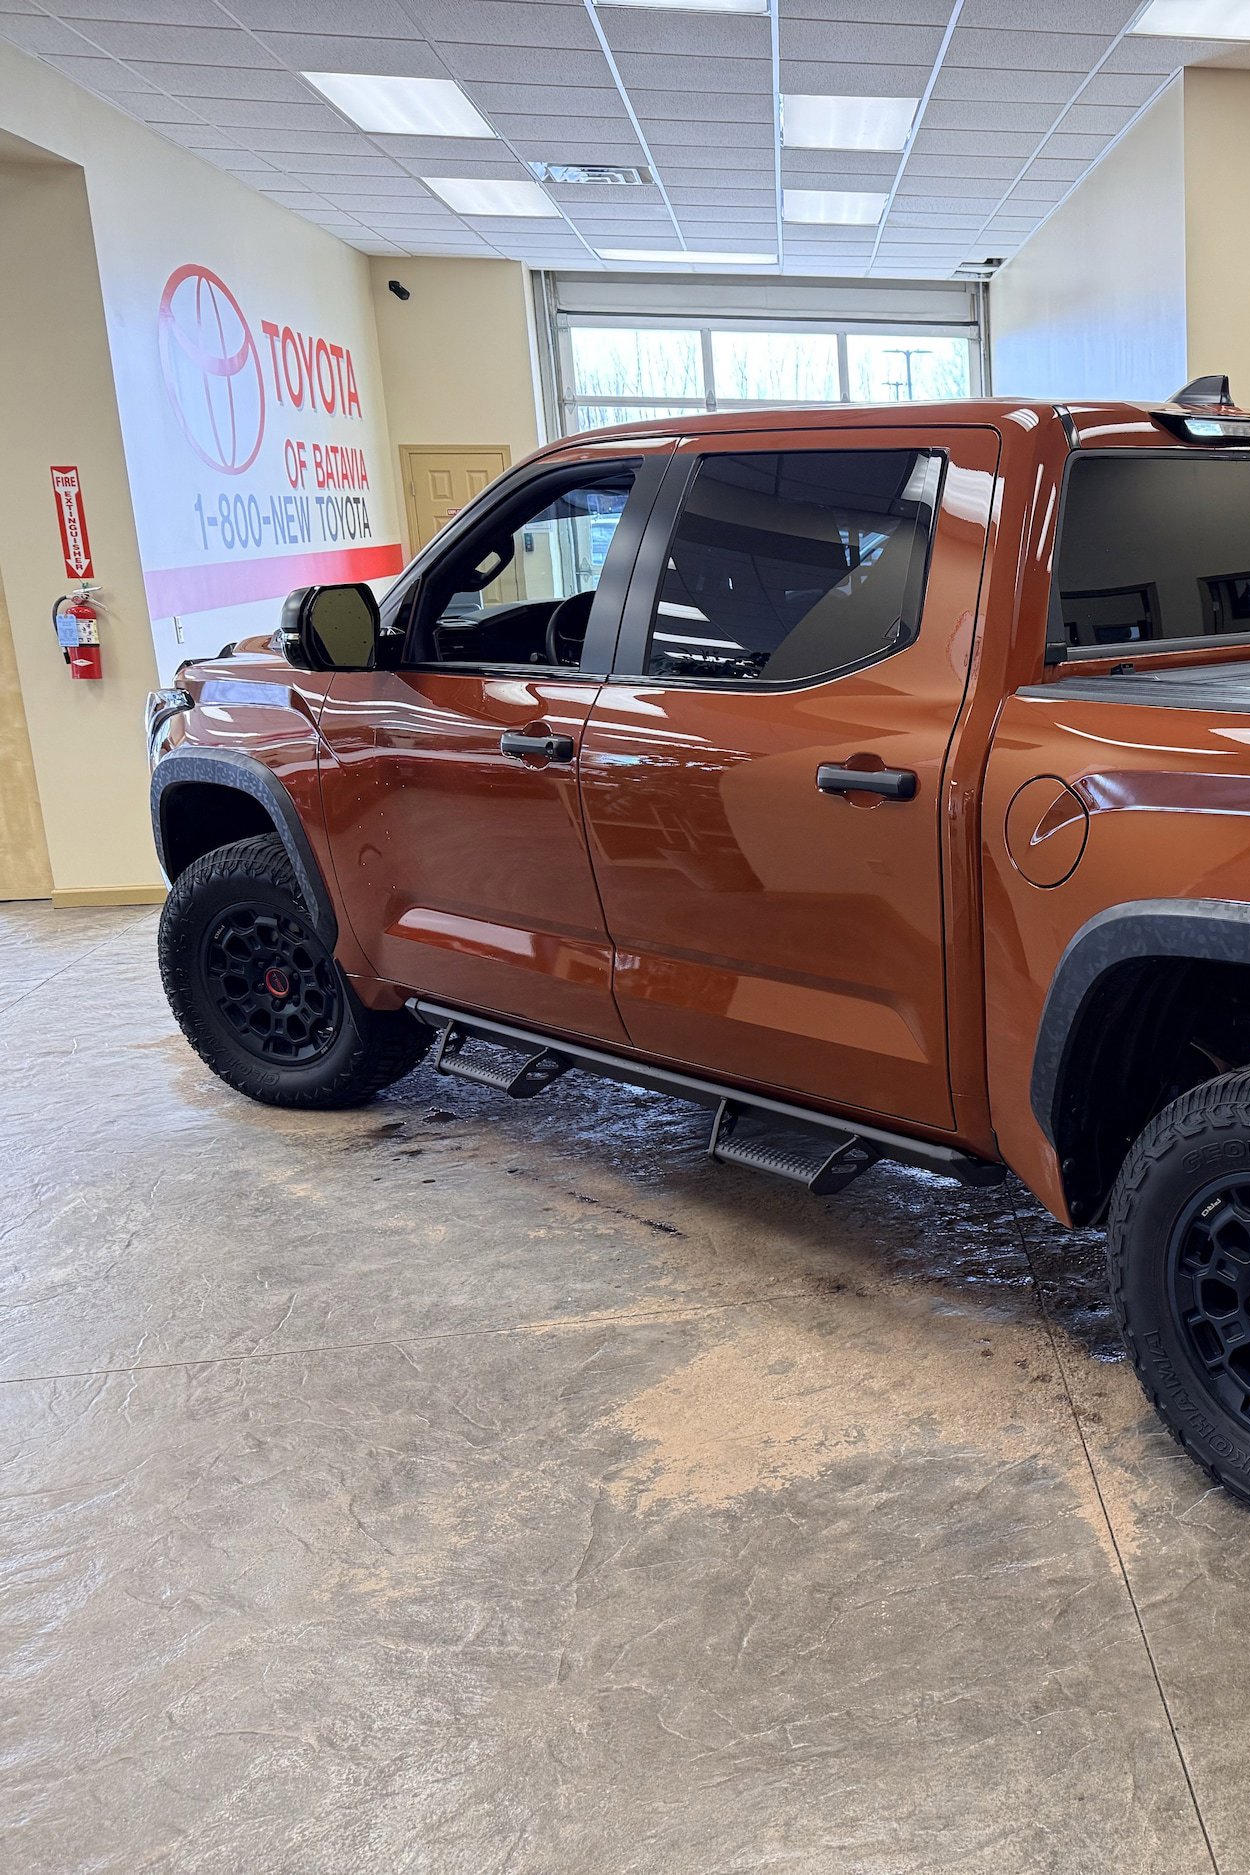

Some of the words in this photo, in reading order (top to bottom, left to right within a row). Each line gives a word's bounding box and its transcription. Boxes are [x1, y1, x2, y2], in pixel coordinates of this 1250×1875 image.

[261, 319, 363, 419] TOYOTA
[55, 476, 76, 487] FIRE
[284, 438, 307, 490] OF
[312, 443, 370, 490] BATAVIA
[64, 491, 83, 570] EXTINGUISHER
[194, 493, 311, 550] 1-800-NEW
[315, 497, 372, 542] TOYOTA
[1201, 1198, 1221, 1218] PRO
